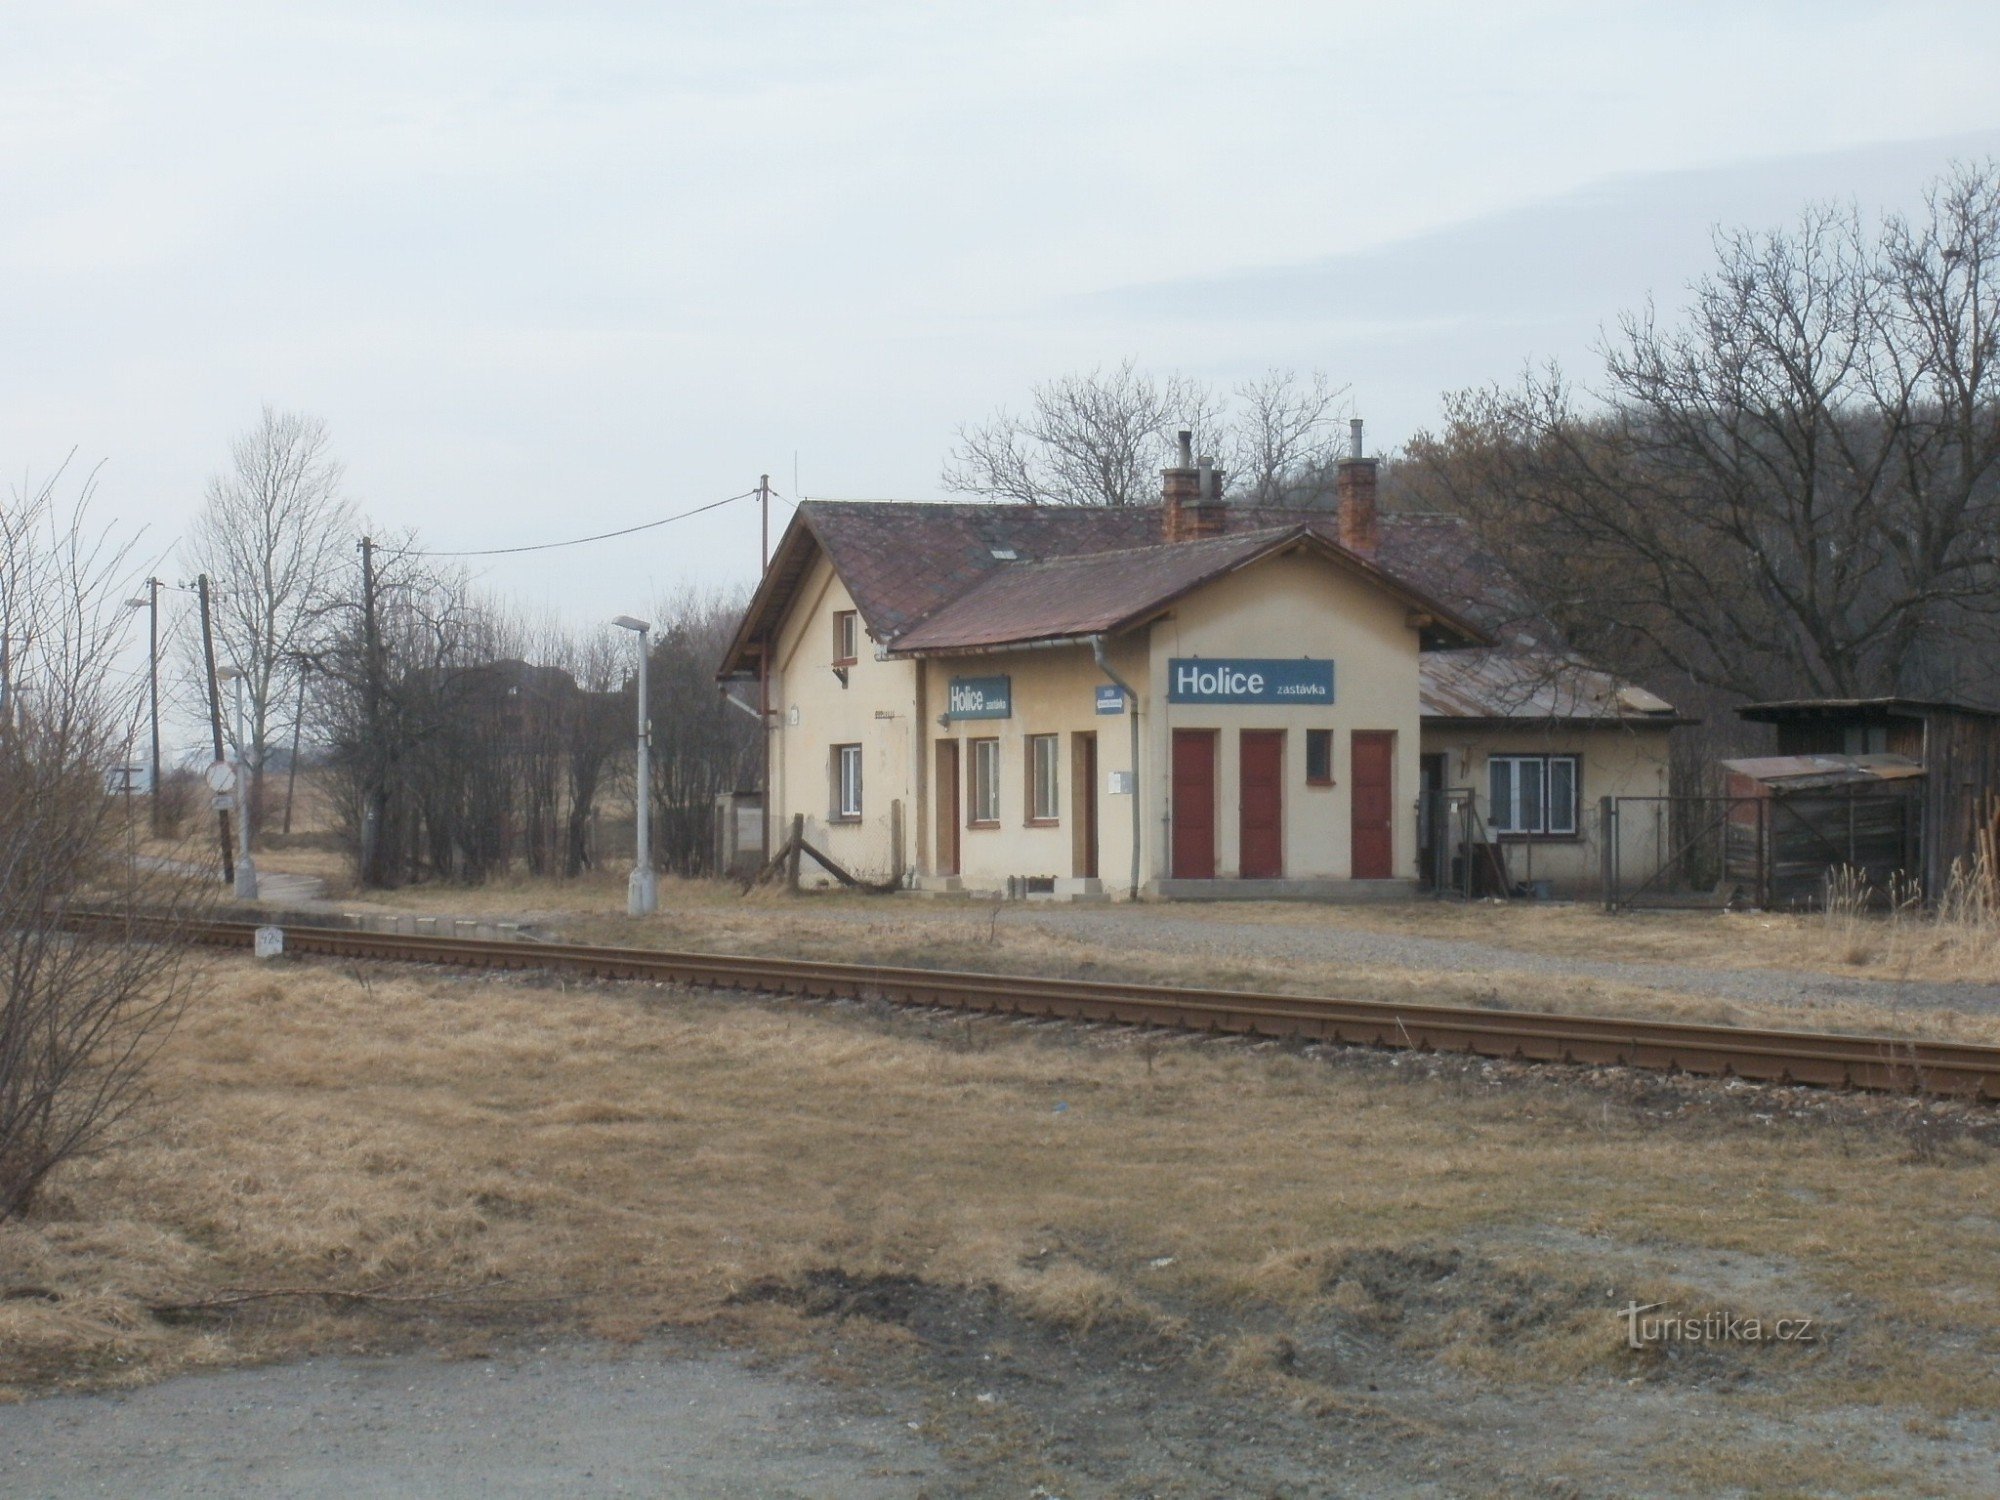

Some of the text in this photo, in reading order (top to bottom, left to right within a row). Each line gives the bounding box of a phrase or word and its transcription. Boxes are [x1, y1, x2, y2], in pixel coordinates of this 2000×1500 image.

[1177, 666, 1326, 695] Holice zastávka
[951, 685, 983, 712] Holice
